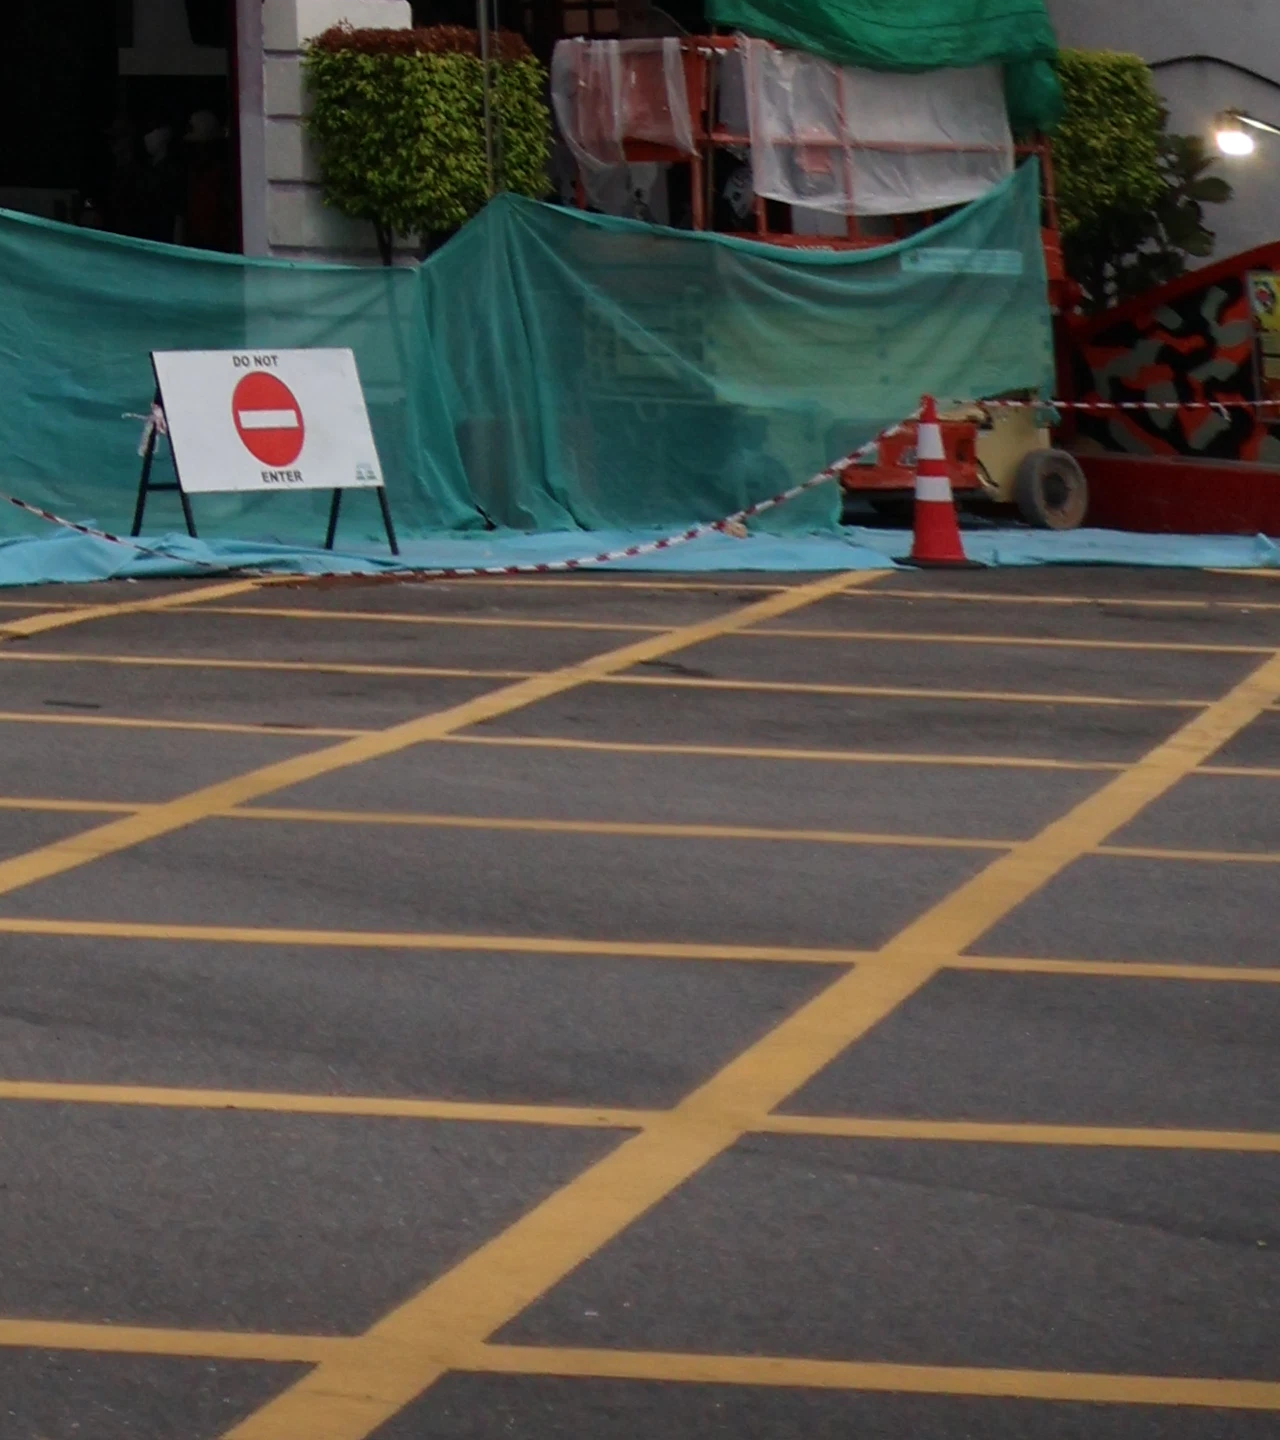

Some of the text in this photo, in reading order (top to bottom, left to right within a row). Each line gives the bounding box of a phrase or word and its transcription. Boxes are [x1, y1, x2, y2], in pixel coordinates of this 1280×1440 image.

[232, 355, 278, 367] DO NOT
[261, 470, 304, 483] ENTER
